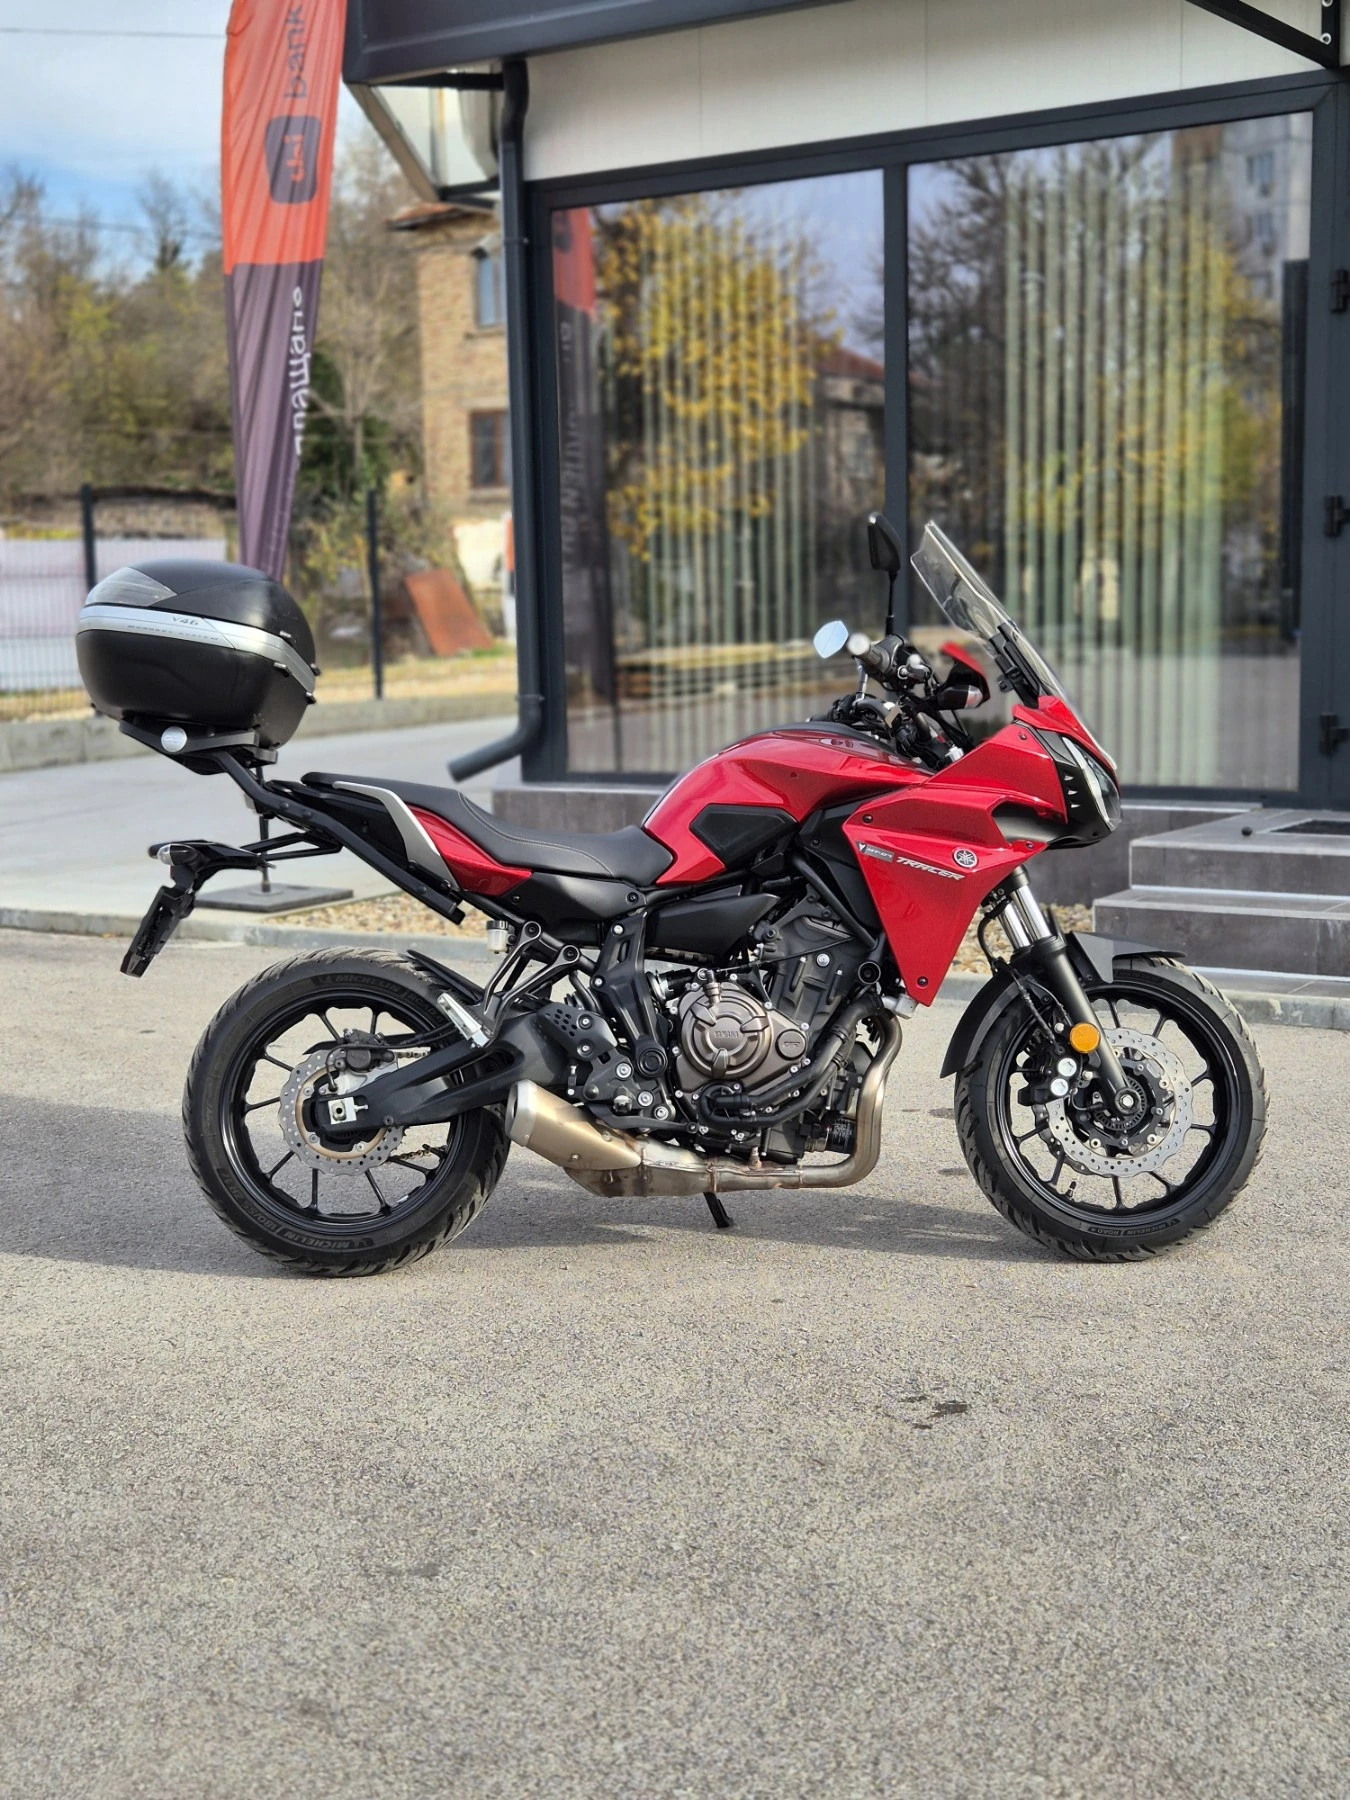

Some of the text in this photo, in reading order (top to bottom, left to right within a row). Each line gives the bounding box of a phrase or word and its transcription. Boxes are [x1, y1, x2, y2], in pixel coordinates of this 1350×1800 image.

[284, 4, 307, 99] bank
[896, 856, 966, 881] TRACER
[335, 974, 400, 993] MICHELIN
[283, 1229, 350, 1249] MICHELIN
[1097, 1228, 1119, 1236] ROAD
[1127, 1223, 1166, 1236] MICHELIN
